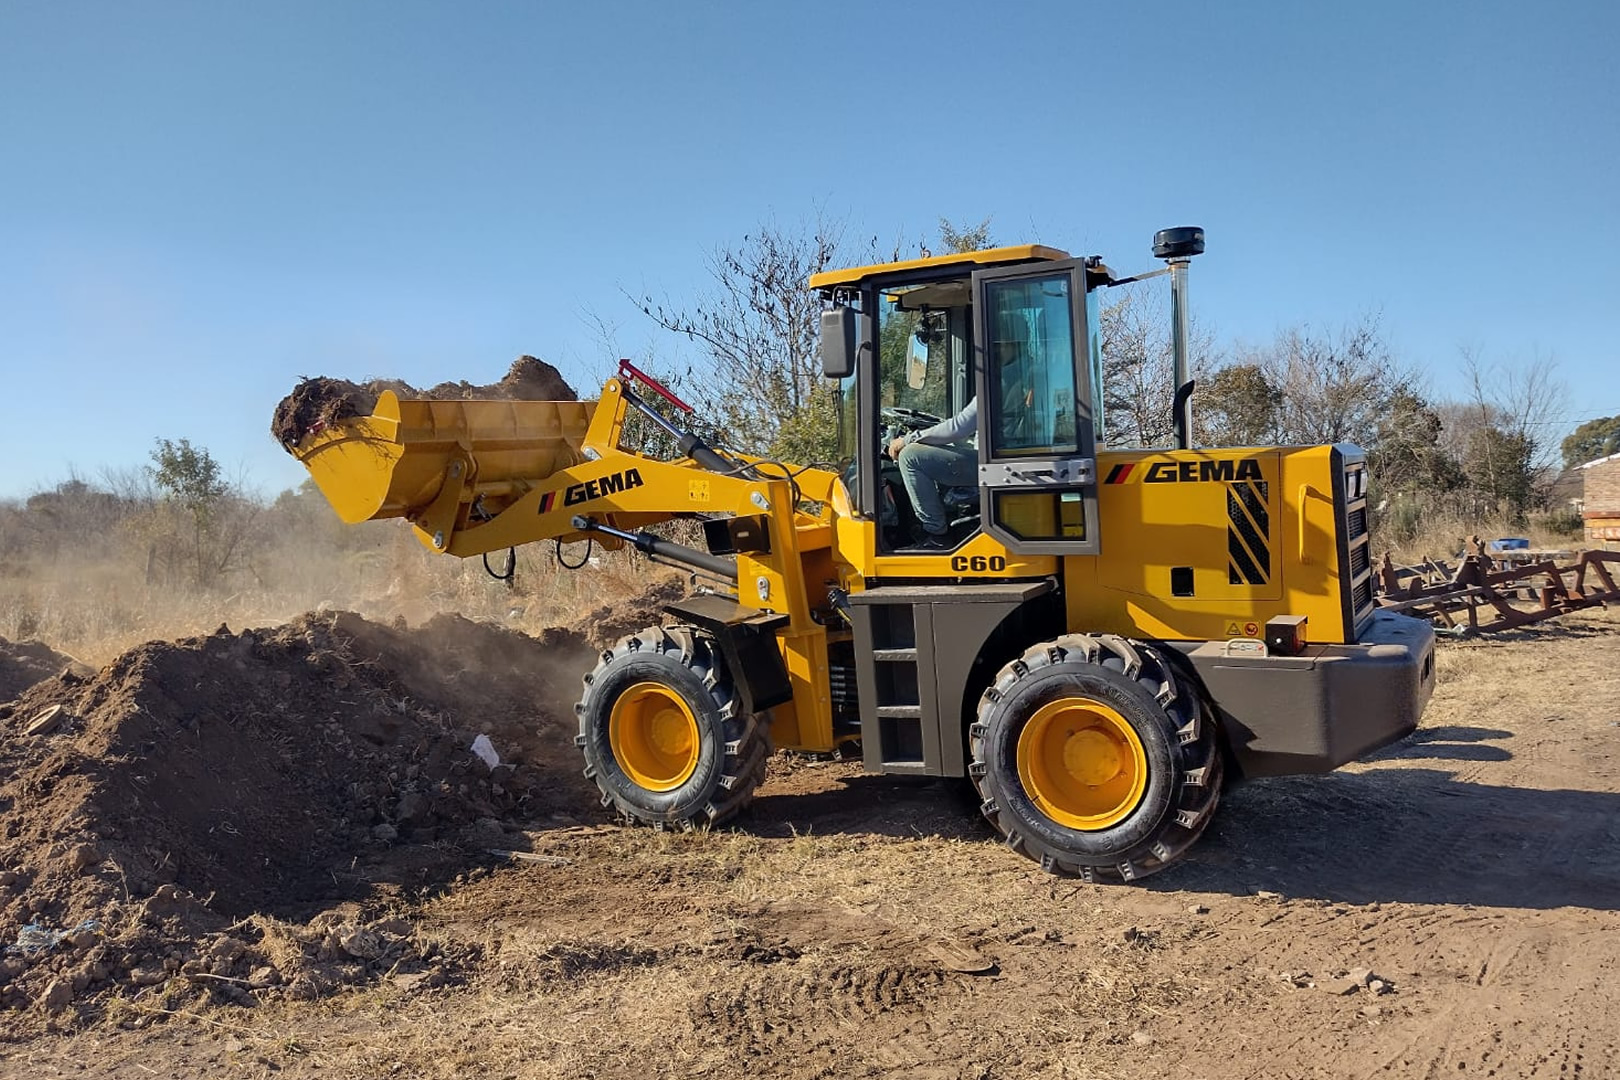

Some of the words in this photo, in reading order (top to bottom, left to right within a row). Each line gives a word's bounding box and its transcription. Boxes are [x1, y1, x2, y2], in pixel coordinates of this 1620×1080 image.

[1144, 460, 1264, 482] GEMA
[564, 468, 644, 506] GEMA
[952, 557, 1005, 571] C60
